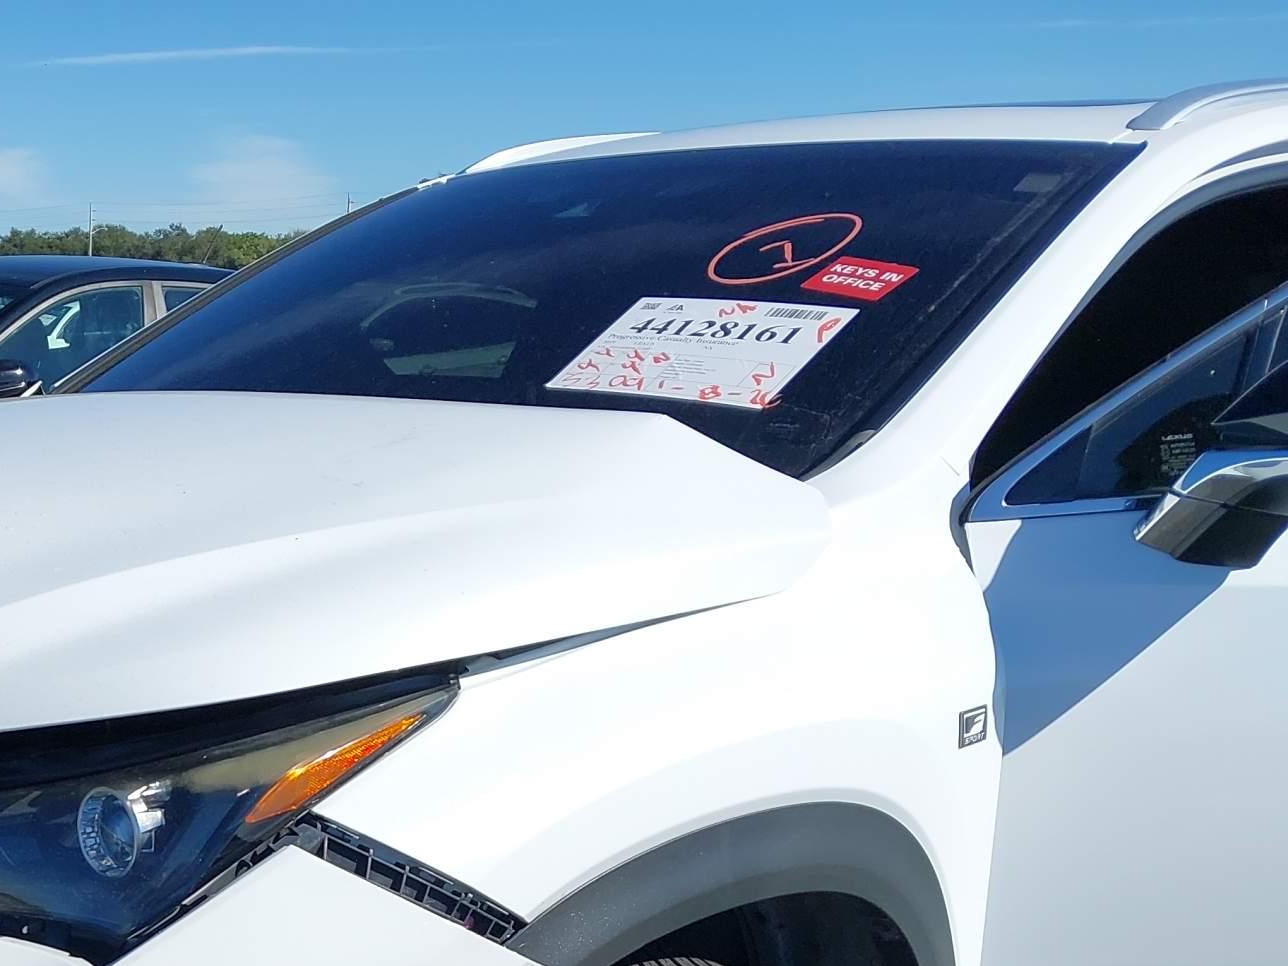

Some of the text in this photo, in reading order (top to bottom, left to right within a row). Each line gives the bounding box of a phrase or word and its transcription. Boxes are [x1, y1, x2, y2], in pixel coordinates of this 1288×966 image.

[830, 263, 904, 282] KEYS IN
[822, 274, 886, 291] OFFICE
[629, 317, 804, 345] 44128161
[657, 335, 692, 344] Casualty
[695, 338, 740, 346] Insurance
